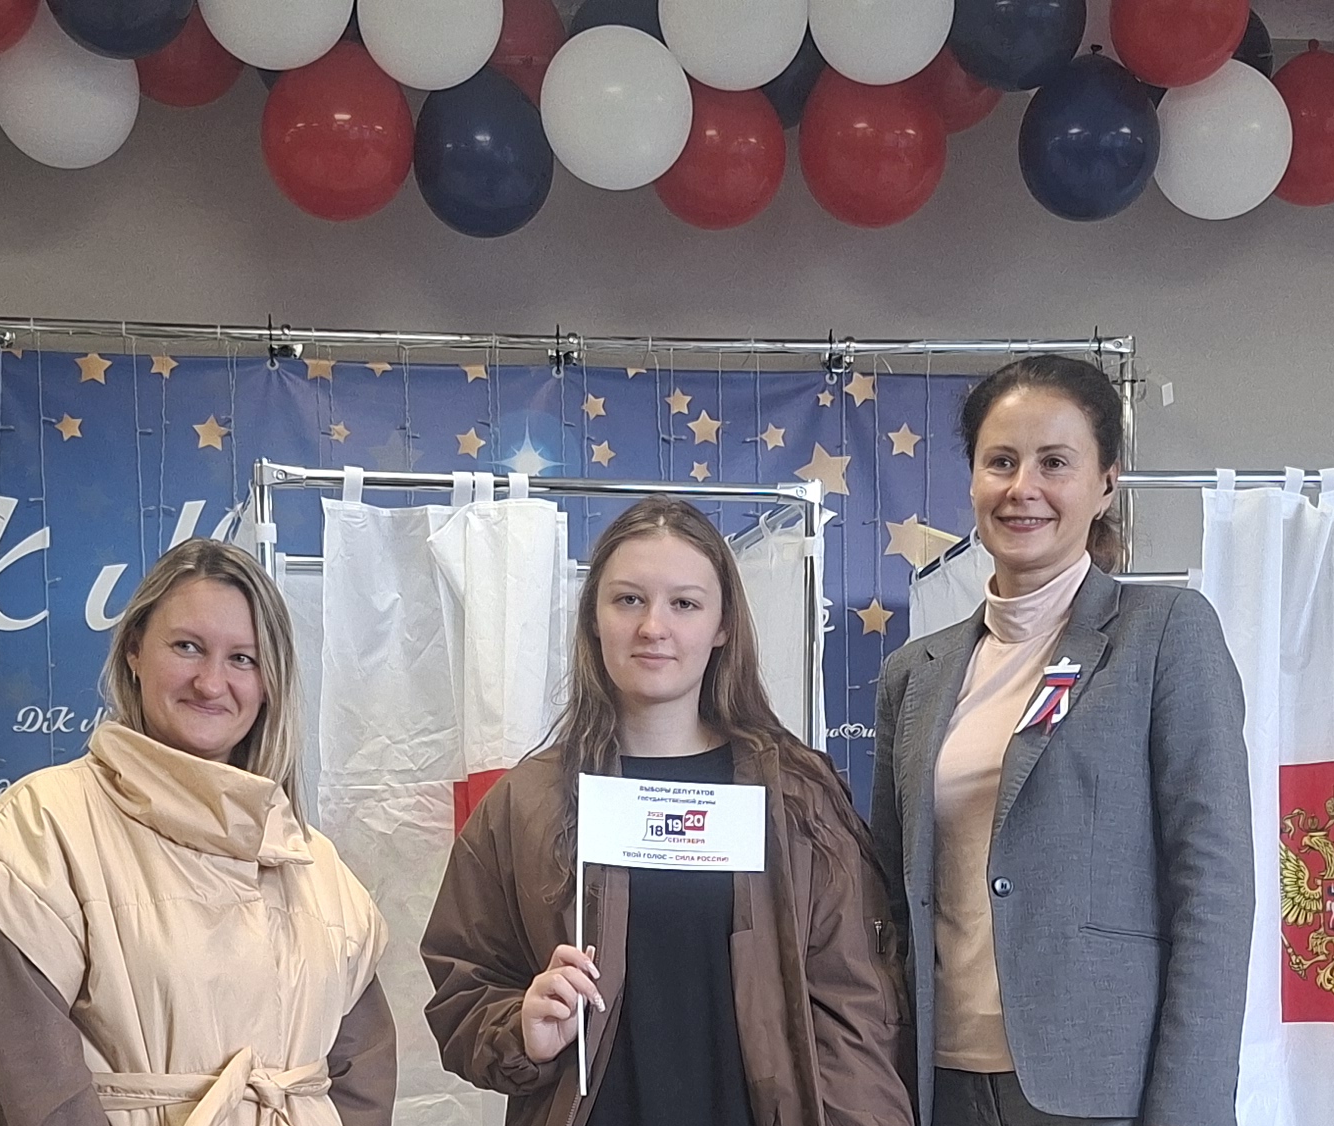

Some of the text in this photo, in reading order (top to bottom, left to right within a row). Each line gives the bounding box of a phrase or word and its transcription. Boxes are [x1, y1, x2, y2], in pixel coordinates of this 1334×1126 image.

[649, 814, 704, 837] 18 19 20
